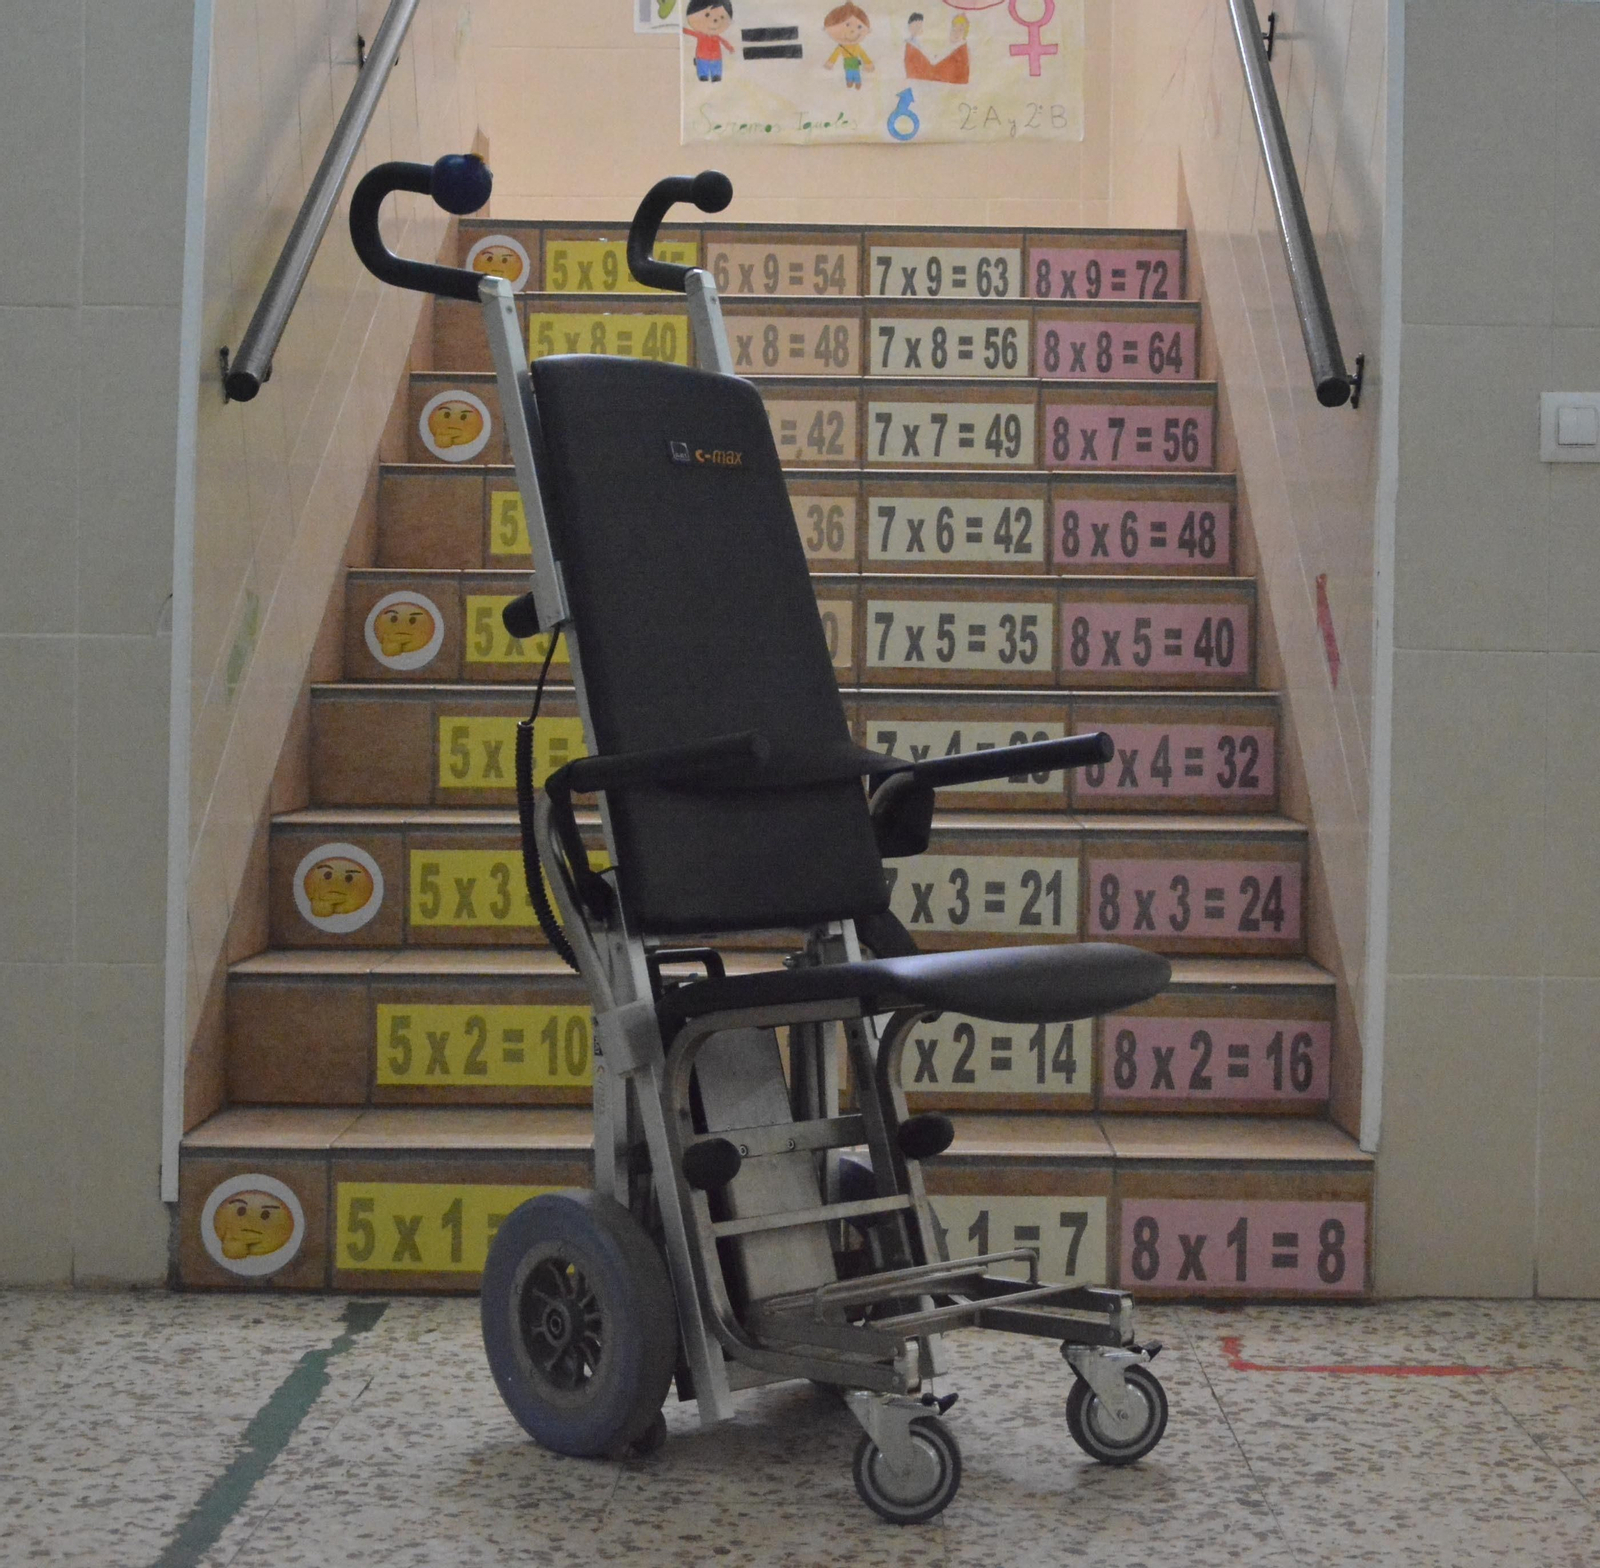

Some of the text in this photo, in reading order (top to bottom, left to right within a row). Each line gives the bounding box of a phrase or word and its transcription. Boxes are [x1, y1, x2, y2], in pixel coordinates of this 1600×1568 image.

[552, 250, 568, 290] 5
[577, 261, 593, 290] x
[602, 250, 618, 291] 9
[714, 253, 729, 293] 6
[739, 264, 754, 293] x
[764, 253, 779, 294] 9
[789, 262, 803, 286] =
[813, 254, 846, 295] 54
[877, 256, 1009, 297] 7 x 9 = 63
[1036, 259, 1168, 299] 8 x 9 = 72
[538, 321, 554, 359] 5
[617, 331, 632, 355] =
[642, 322, 677, 363] 40
[736, 324, 849, 368] x 8 = 48
[879, 326, 1017, 370] 7 x 8 = 56
[1044, 330, 1183, 374] 8 x 8 = 64
[695, 449, 742, 465] c-max
[781, 411, 844, 456] = 42
[876, 413, 1022, 459] 7 x 7 = 49
[1053, 417, 1199, 463] 8 x 7 = 56
[500, 500, 518, 547] 5
[807, 504, 845, 553] 36
[878, 506, 1032, 554] 7 x 6 = 42
[1062, 511, 1216, 559] 8 x 6 = 48
[474, 607, 494, 657] 5
[875, 612, 1038, 665] 7 x 5 = 35
[1071, 617, 1234, 668] 8 x 5 = 40
[450, 726, 471, 779] 5
[482, 740, 504, 779] x
[1117, 749, 1138, 788] x
[1150, 735, 1172, 788] 4
[1185, 748, 1204, 776] =
[1216, 735, 1260, 790] 32
[419, 862, 511, 920] 5 x 3
[910, 883, 934, 924] x
[947, 868, 970, 925] 3
[985, 882, 1006, 913] =
[1019, 869, 1062, 927] 21
[1099, 873, 1285, 932] 8 x 3 = 24
[388, 1015, 588, 1077] 5 x 2 = 10
[914, 1022, 1077, 1085] x 2 = 14
[1113, 1030, 1313, 1093] 8 x 2 = 16
[346, 1198, 375, 1263] 5
[392, 1214, 423, 1264] x
[441, 1198, 463, 1264] 1
[1060, 1212, 1088, 1277] 7
[1132, 1216, 1345, 1285] 8 x 1 = 8
